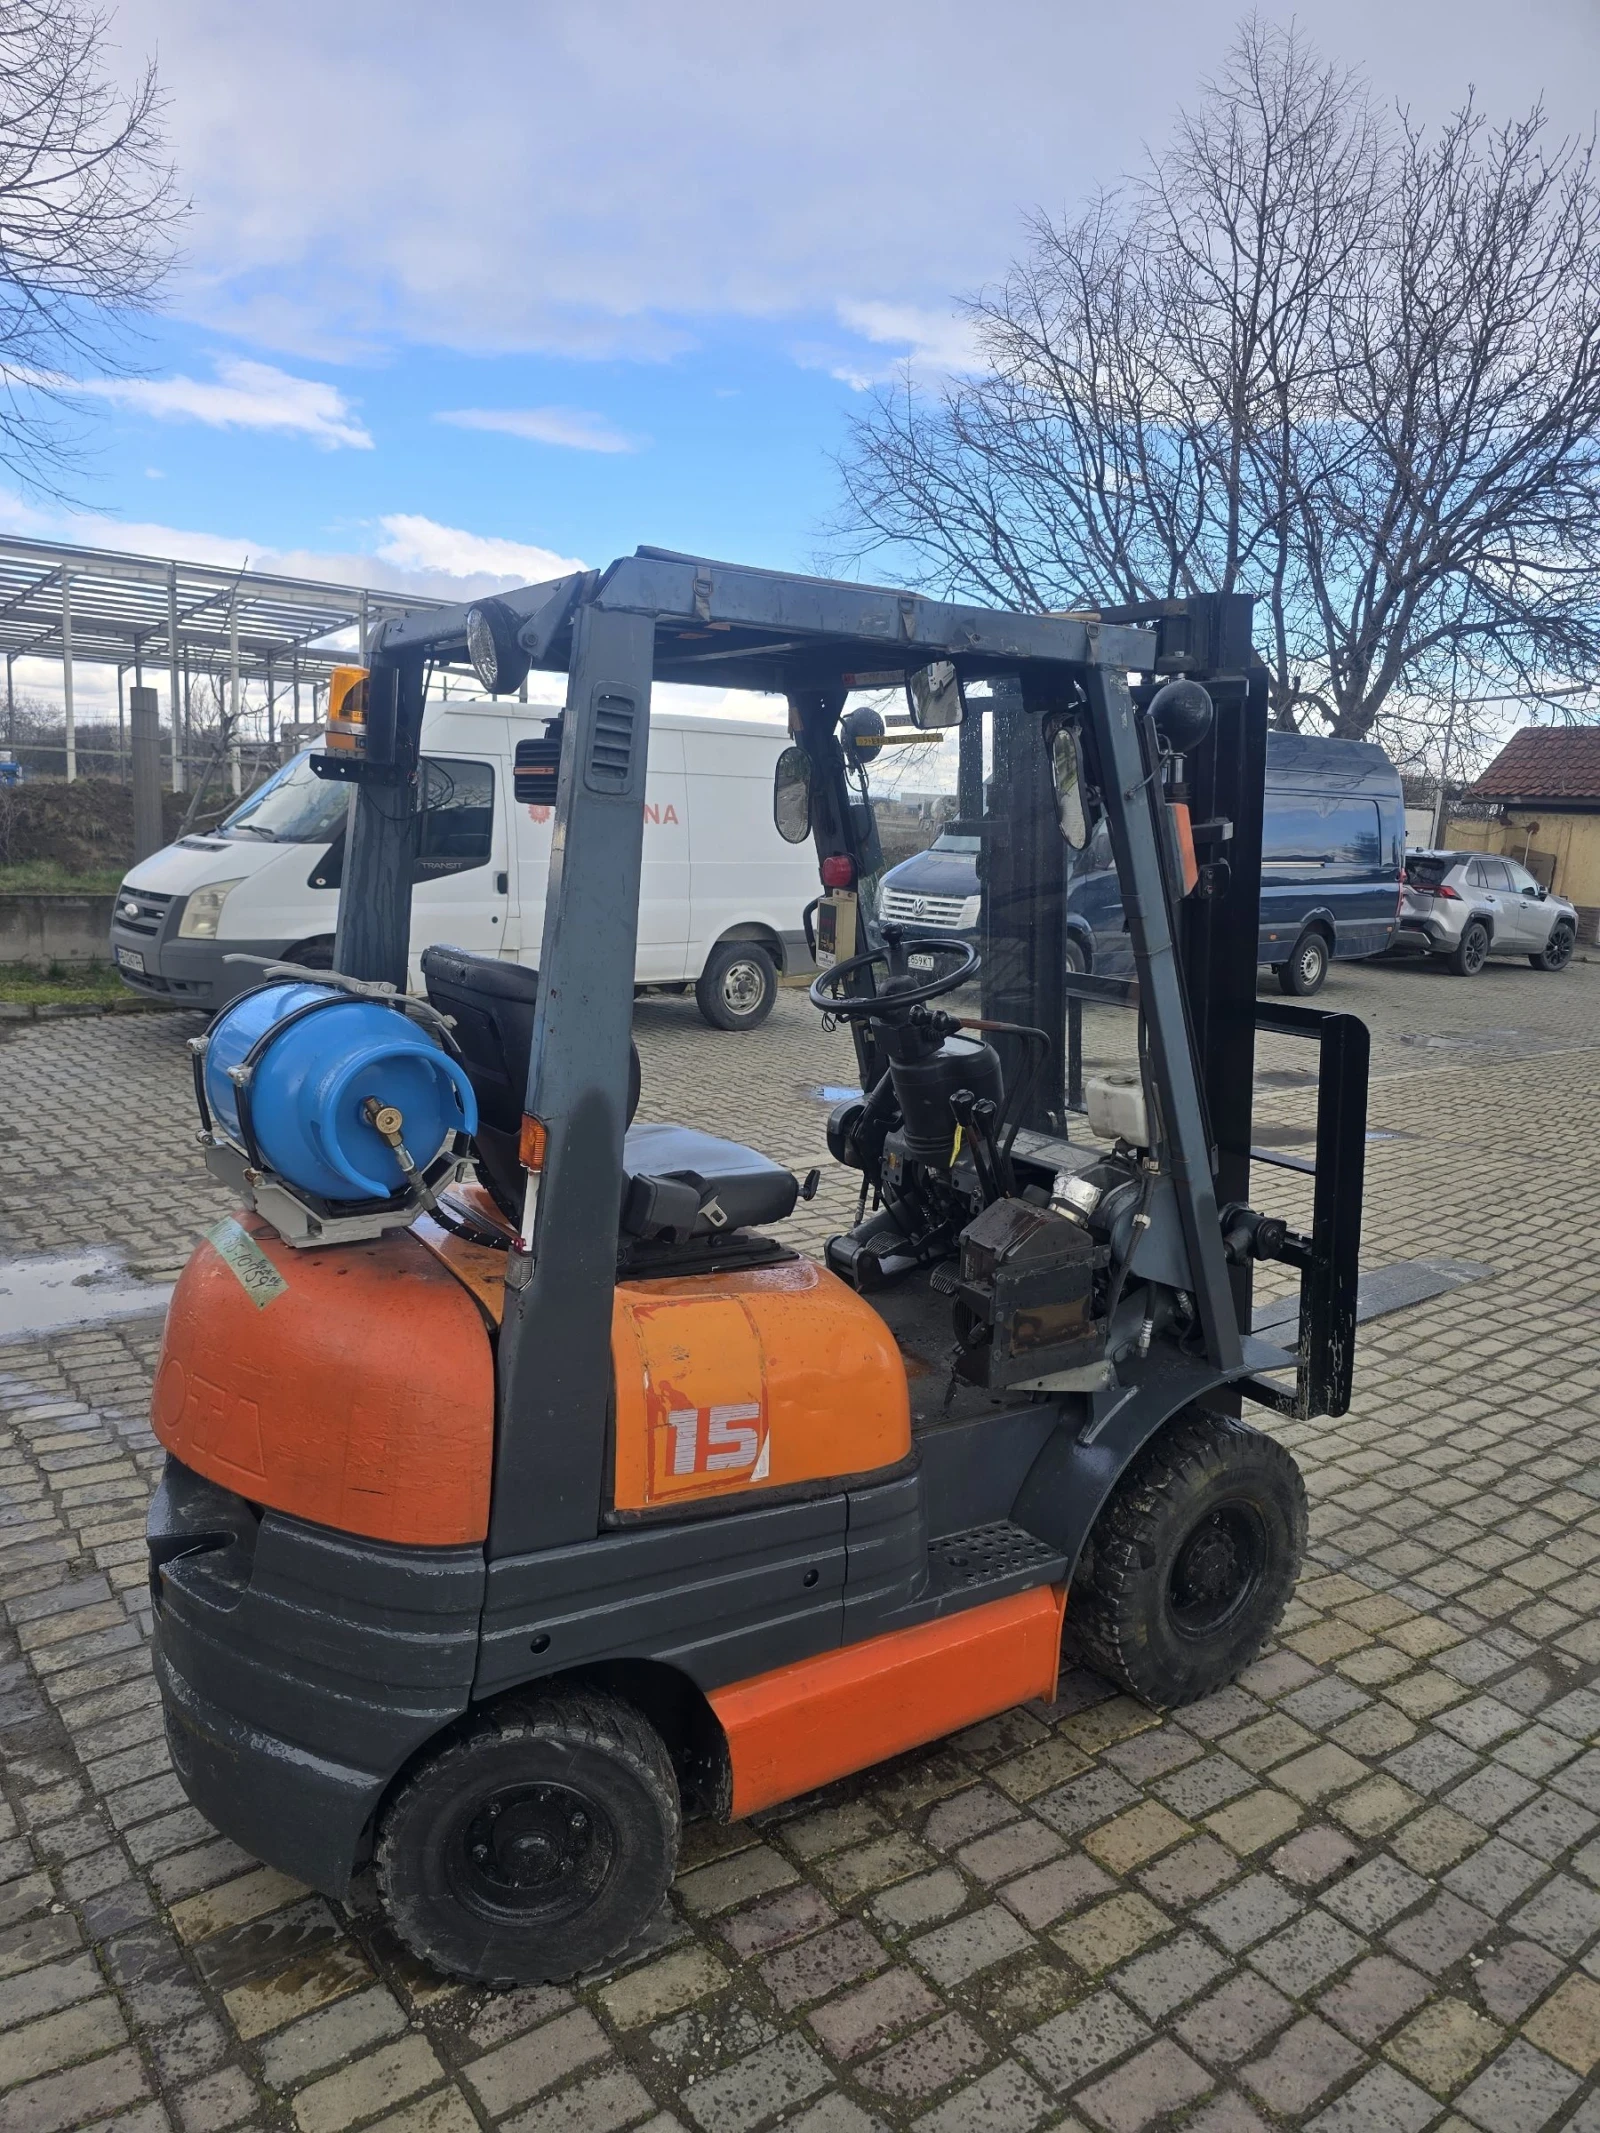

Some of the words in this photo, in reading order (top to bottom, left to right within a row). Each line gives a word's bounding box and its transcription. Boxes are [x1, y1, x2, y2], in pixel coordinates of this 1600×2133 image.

[644, 803, 679, 824] NA
[909, 955, 932, 967] 859KT
[153, 1358, 268, 1482] OTA
[668, 1402, 760, 1475] 15
